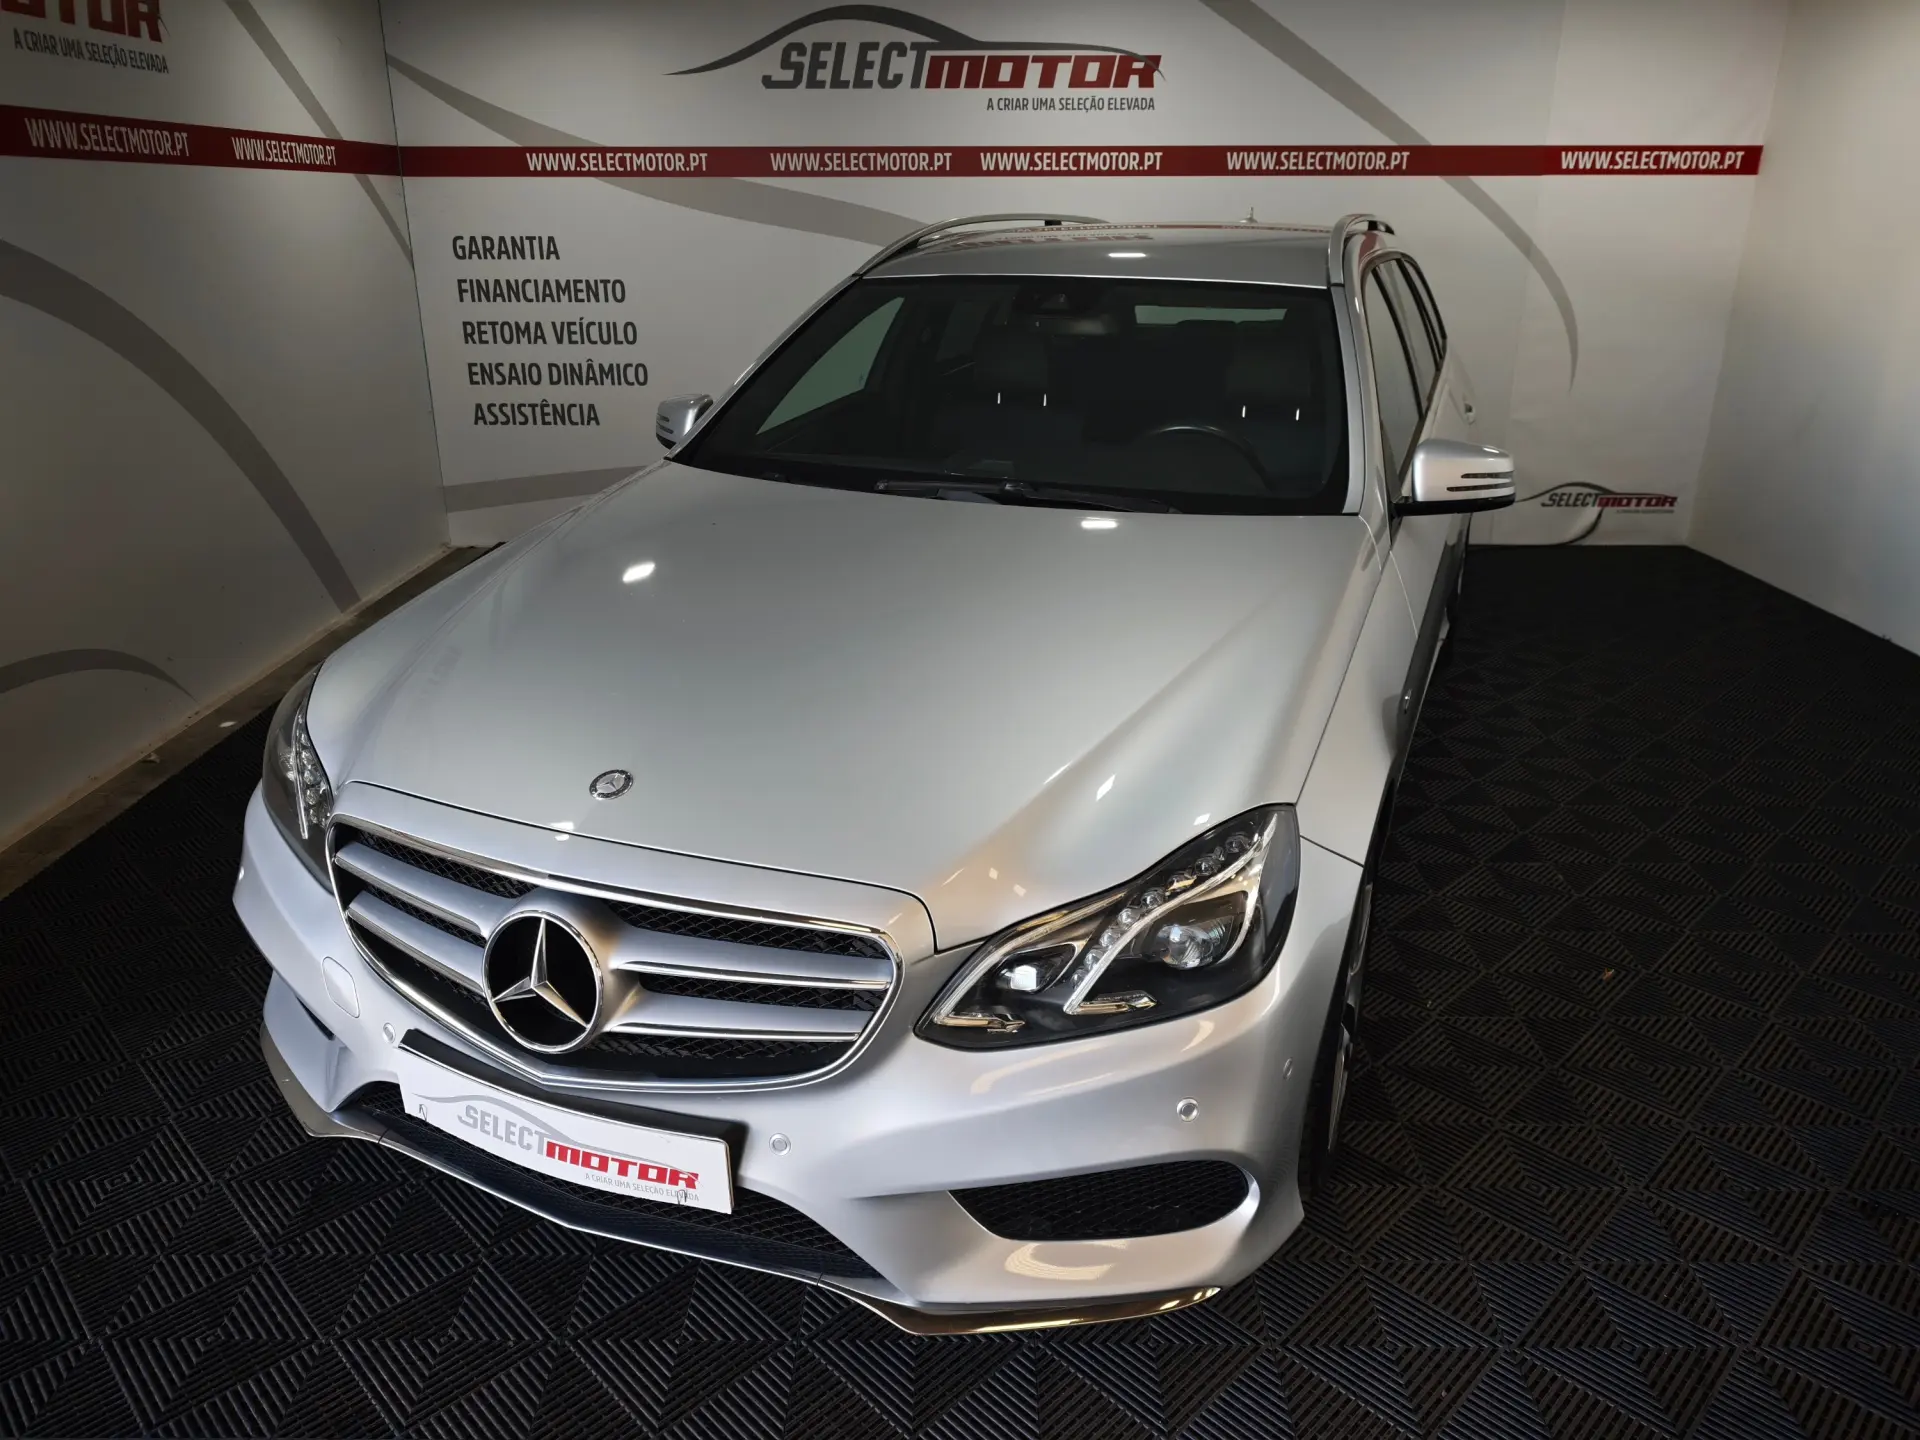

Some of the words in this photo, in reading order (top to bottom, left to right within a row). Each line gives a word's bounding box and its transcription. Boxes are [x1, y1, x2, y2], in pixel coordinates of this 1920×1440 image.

[13, 27, 23, 50] A
[23, 30, 60, 56] CRIAR
[59, 37, 85, 60] UMA
[84, 40, 128, 68] SELEÇÃO
[128, 50, 169, 74] ELEVADA
[986, 97, 994, 111] A
[997, 97, 1029, 111] CRIAR
[1032, 97, 1056, 111] UMA
[1058, 96, 1105, 113] SELEÇÃO
[1107, 97, 1155, 111] ELEVADA
[24, 117, 190, 157] WWW.SELECTMOTOR.PT
[231, 136, 337, 166] WWW.SELECTMOTOR.PT
[526, 152, 708, 172] WWW.SELECTMOTOR.PT
[770, 152, 952, 172] WWW.SELECTMOTOR.PT
[980, 151, 1163, 171] WWW.SELECTMOTOR.PT
[1226, 151, 1410, 171] WWW.SELECTMOTOR.PT
[1560, 151, 1745, 171] WWW.SELECTMOTOR.PT
[452, 235, 560, 260] GARANTIA
[457, 278, 626, 303] FINANCIAMENTO
[462, 320, 547, 345] RETOMA
[551, 317, 638, 345] VEÍCULO
[467, 362, 542, 386] ENSAIO
[547, 357, 649, 387] DINÂMICO
[473, 399, 601, 426] ASSISTÊNCIA
[591, 1174, 613, 1186] CRIAR
[614, 1178, 631, 1190] UMA
